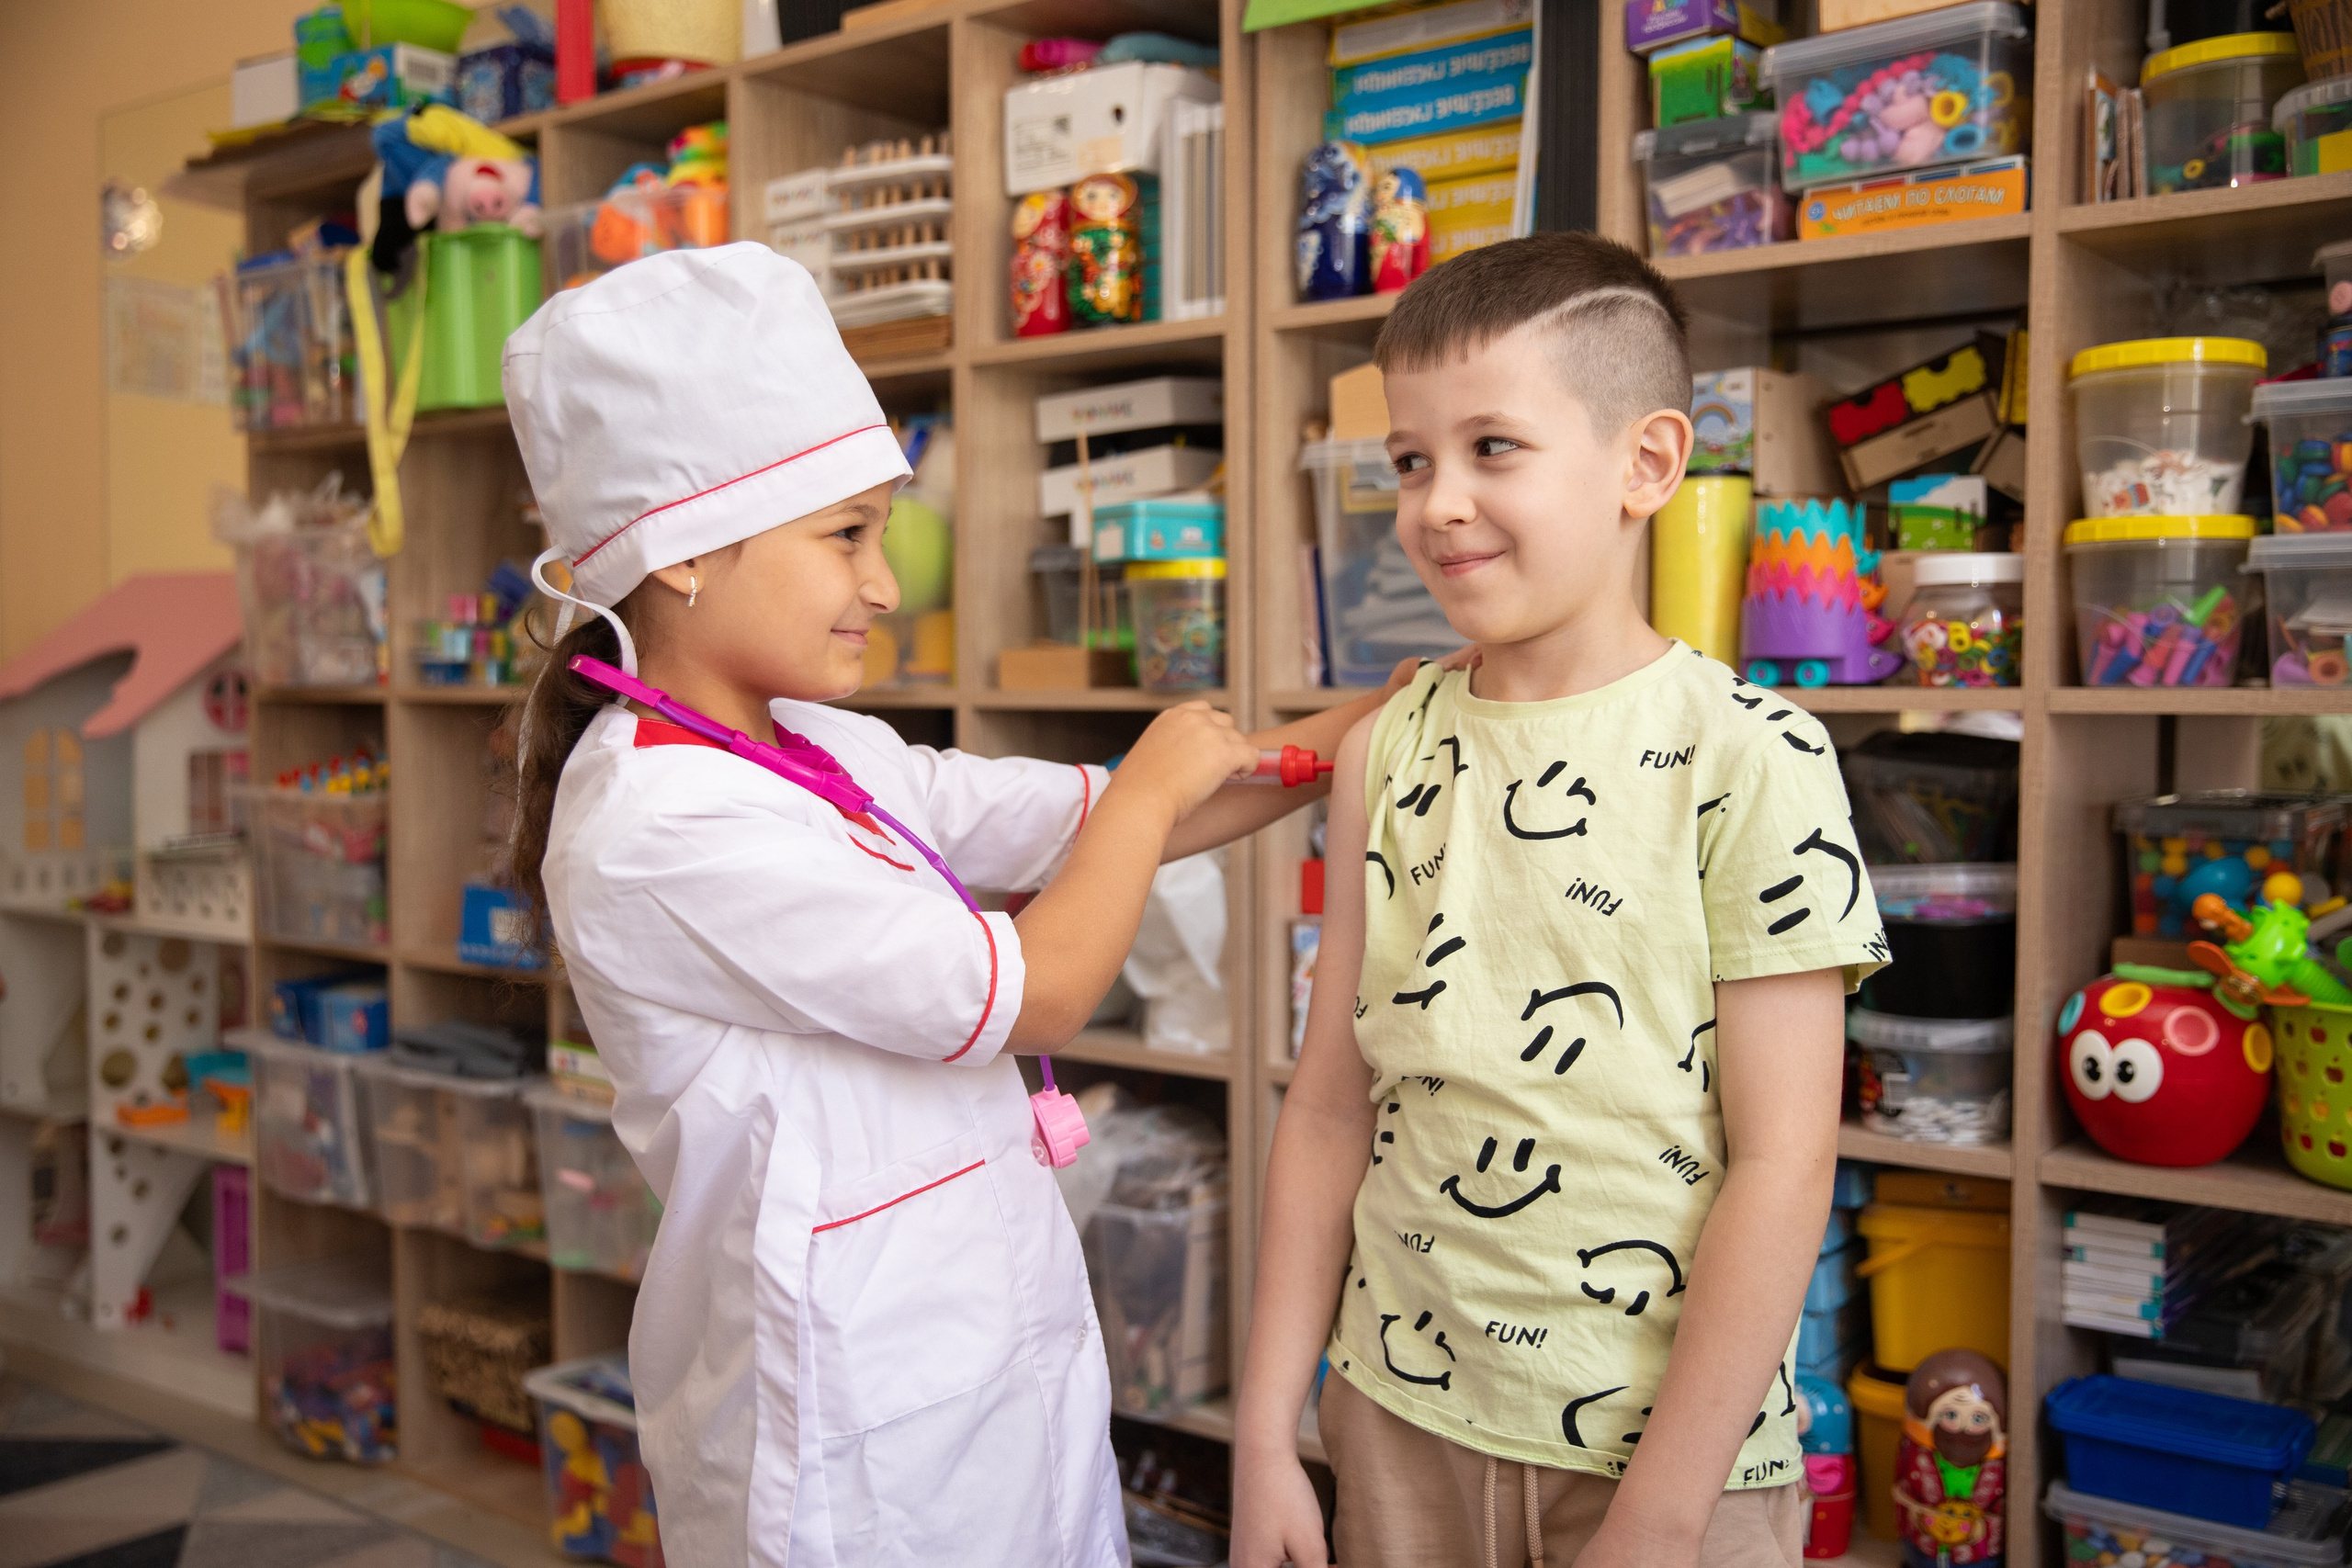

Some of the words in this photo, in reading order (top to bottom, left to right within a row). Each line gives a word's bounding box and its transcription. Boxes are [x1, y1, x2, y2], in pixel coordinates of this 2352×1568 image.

[1832, 192, 1900, 221] ЧИТАЕМ
[1905, 188, 1930, 208] ПО
[1934, 186, 2005, 206] СЛОГАМ
[1640, 744, 1695, 768] FUN!
[1565, 877, 1623, 916] FUN!
[1658, 1145, 1710, 1186] FUN!
[1486, 1321, 1547, 1348] FUN!
